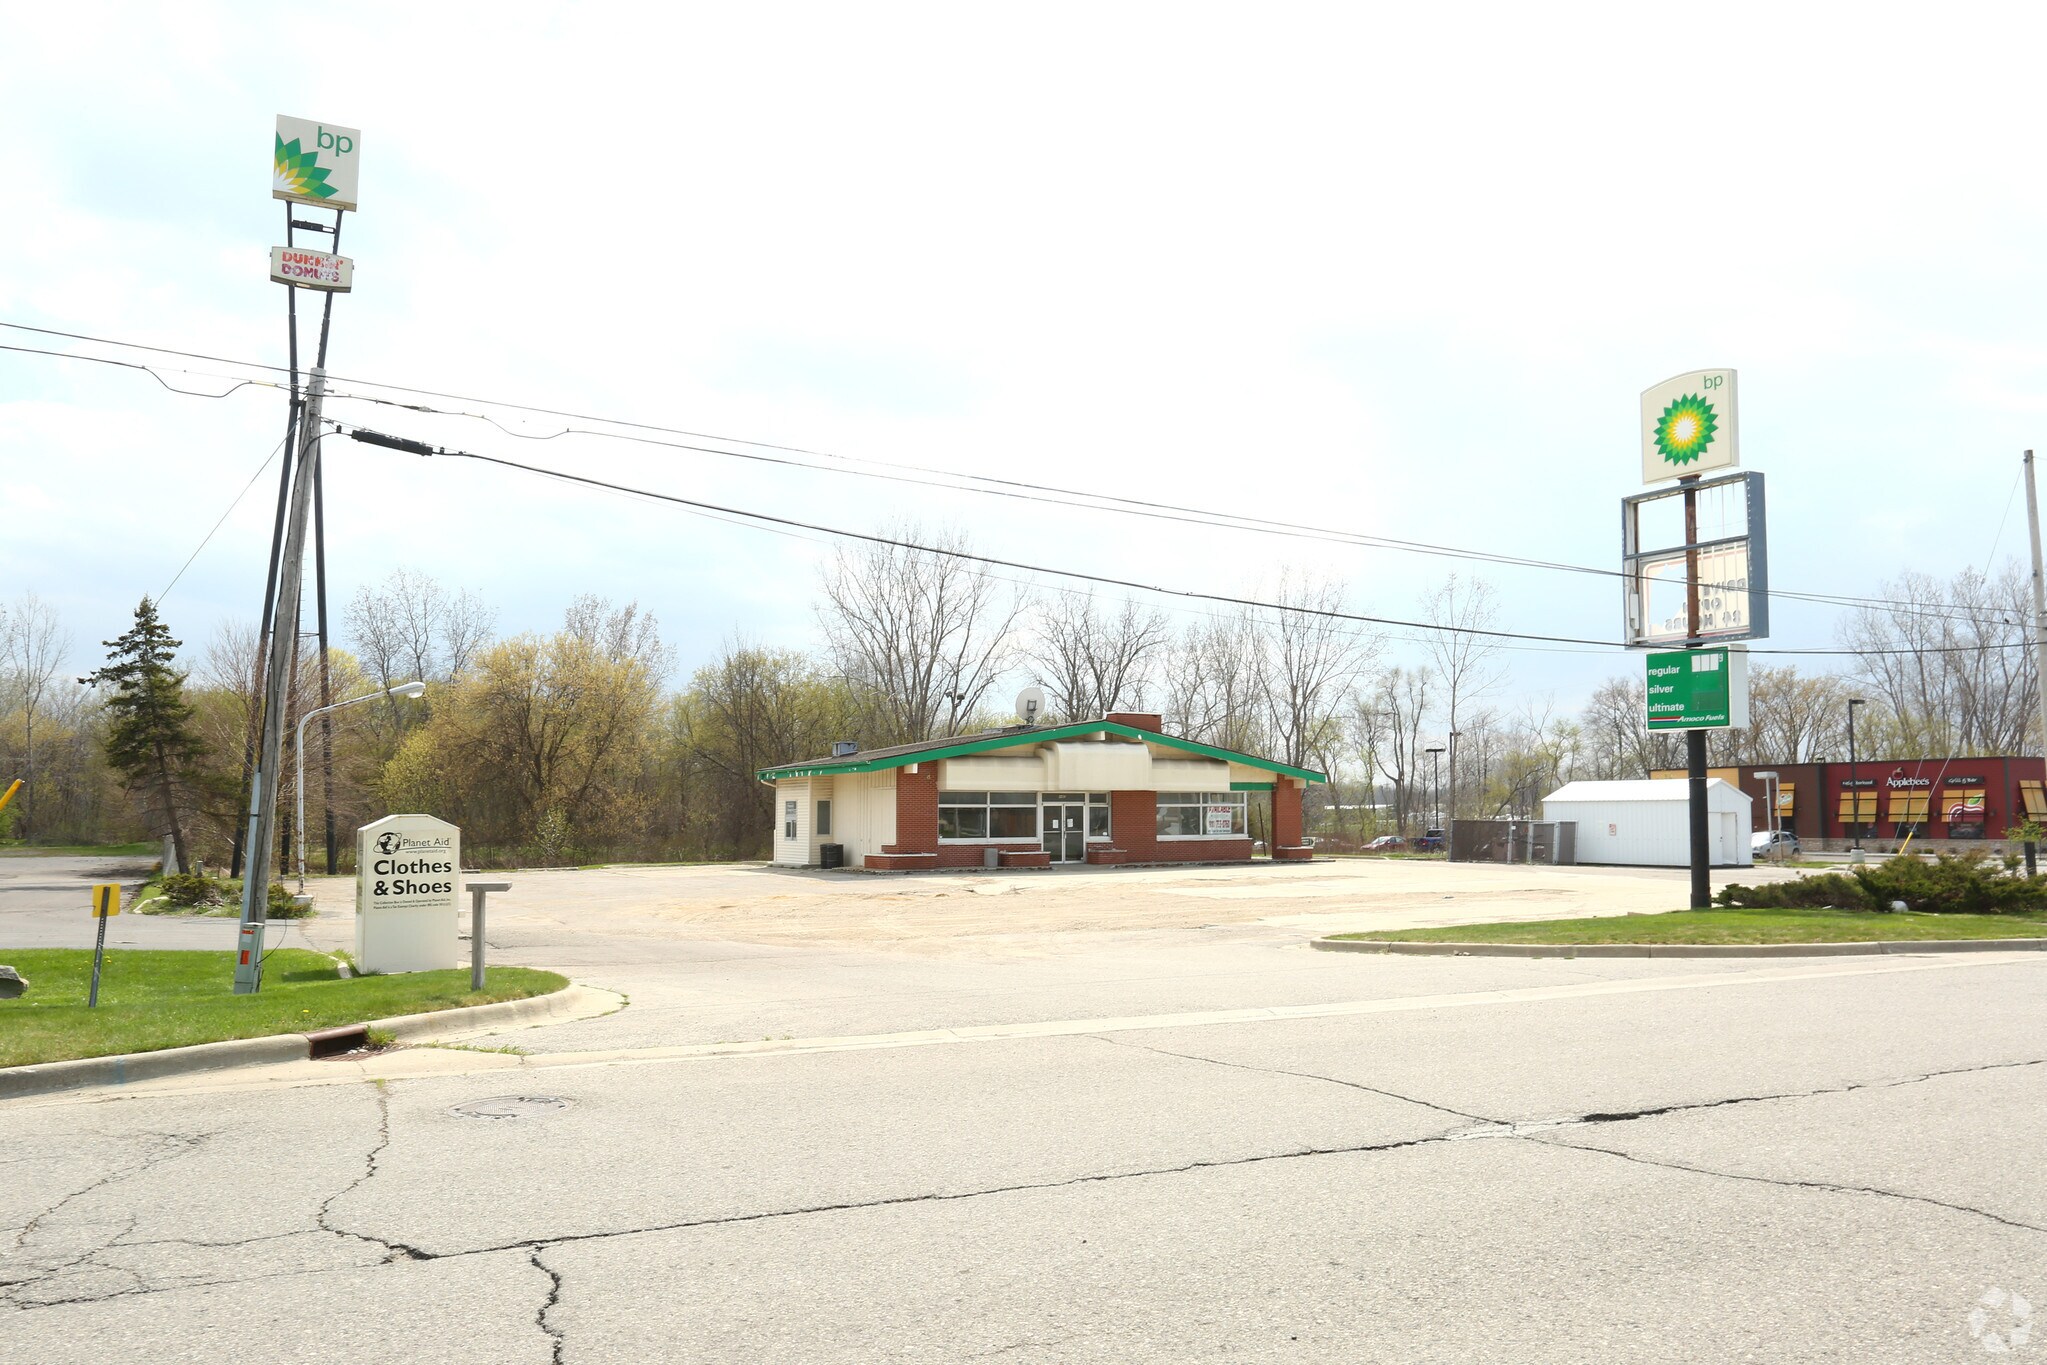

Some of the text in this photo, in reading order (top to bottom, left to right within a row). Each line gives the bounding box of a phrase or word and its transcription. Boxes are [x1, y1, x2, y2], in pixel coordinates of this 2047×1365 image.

[317, 126, 353, 157] bp
[1703, 375, 1723, 391] bp
[1648, 665, 1680, 677] regular
[1649, 685, 1674, 694] silver
[1649, 702, 1685, 712] ultimate
[1705, 713, 1725, 721] Fuels
[1886, 777, 1930, 788] Applebee's
[402, 837, 450, 847] Planet Aid
[373, 858, 452, 875] Clothes
[373, 879, 452, 896] & Shoes
